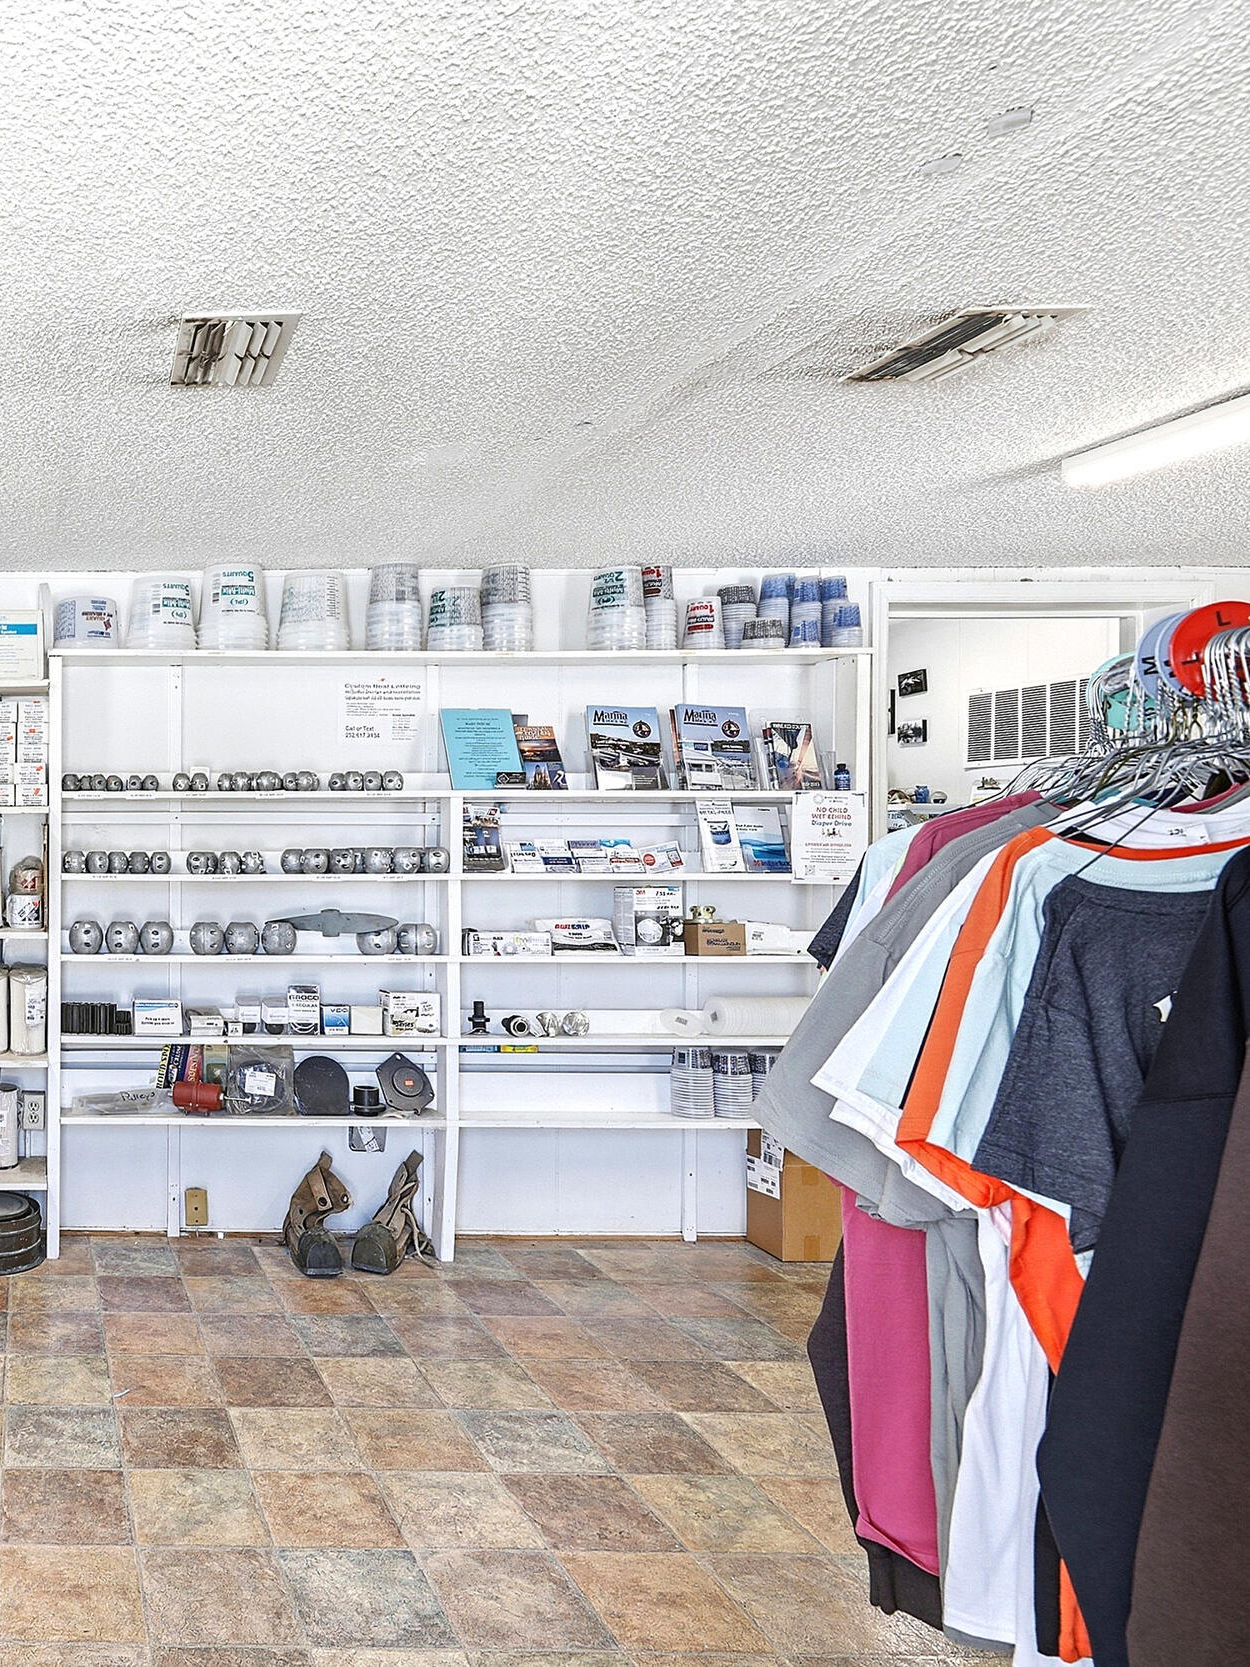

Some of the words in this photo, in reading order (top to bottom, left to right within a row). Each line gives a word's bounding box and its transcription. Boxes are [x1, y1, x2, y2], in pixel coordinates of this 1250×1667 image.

[247, 570, 255, 582] 5
[1216, 611, 1232, 627] L
[1141, 656, 1159, 676] M
[1182, 652, 1199, 666] L
